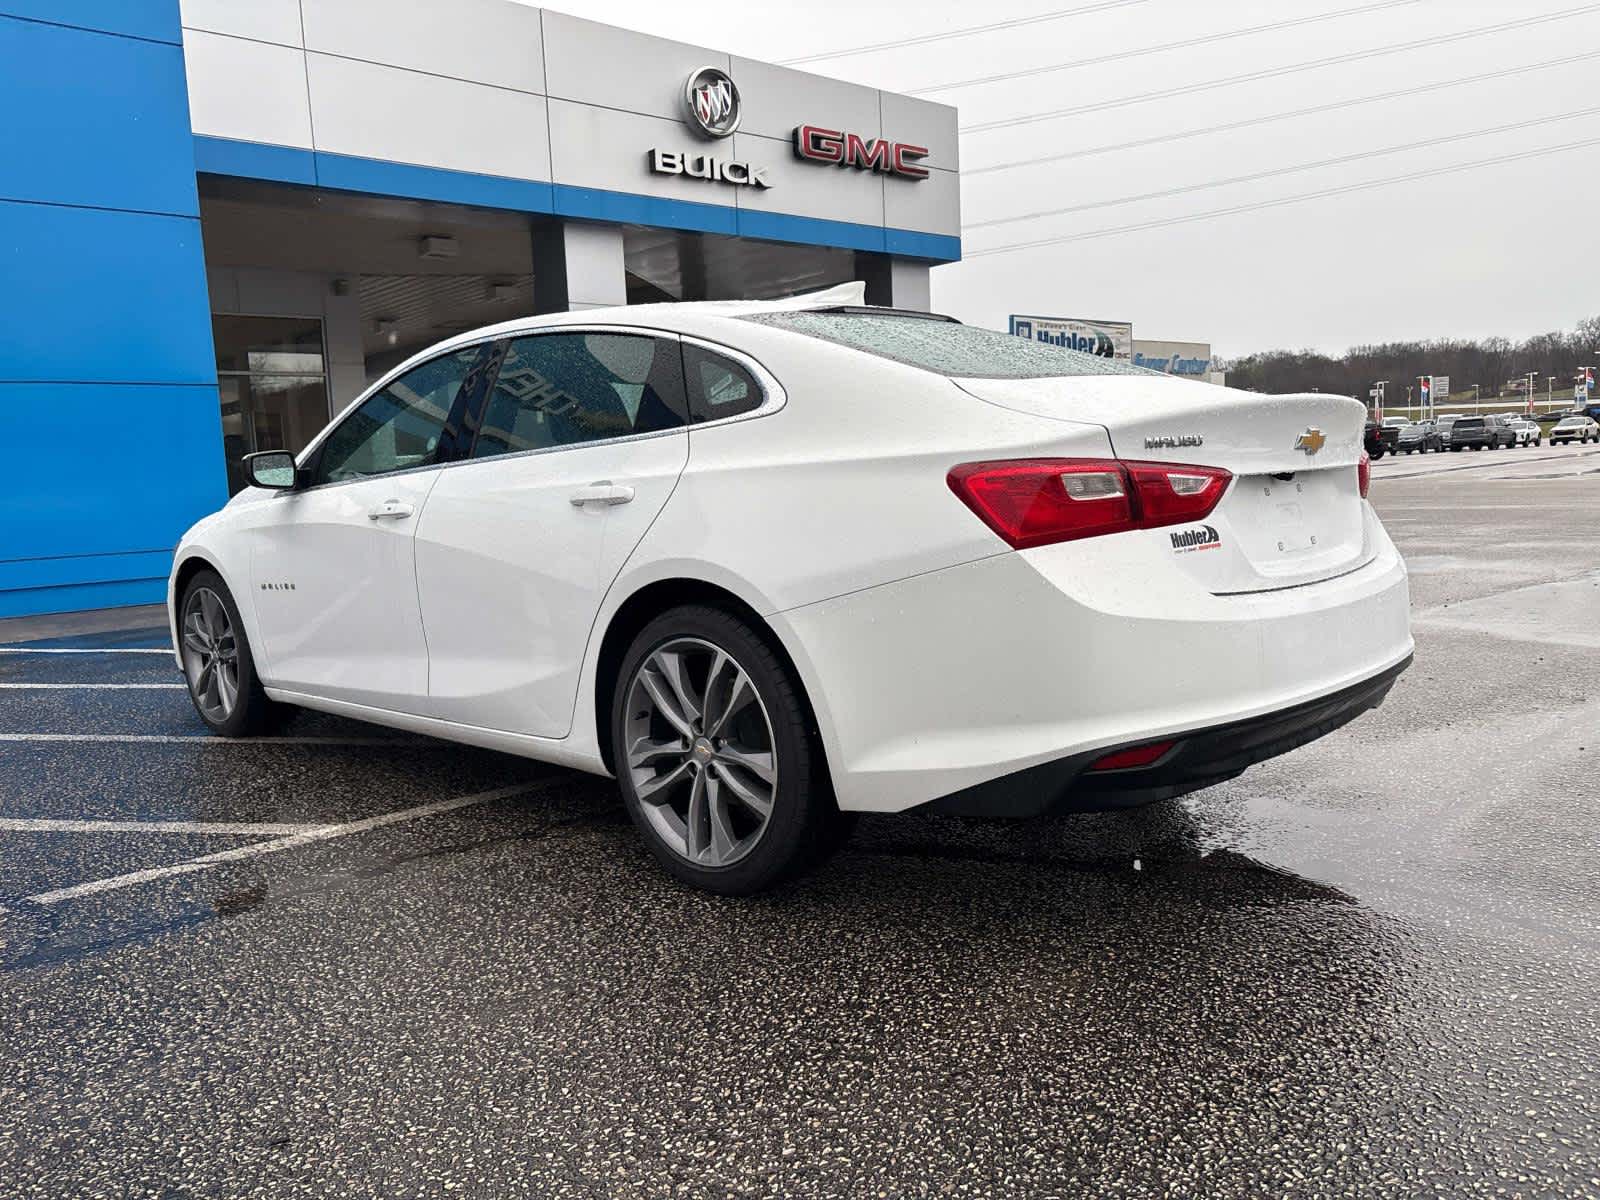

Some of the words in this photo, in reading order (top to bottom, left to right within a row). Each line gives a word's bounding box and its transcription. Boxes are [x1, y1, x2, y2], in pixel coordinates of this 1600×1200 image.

[650, 148, 774, 189] BUICK
[796, 124, 929, 179] GMC
[1170, 530, 1208, 548] Hubler
